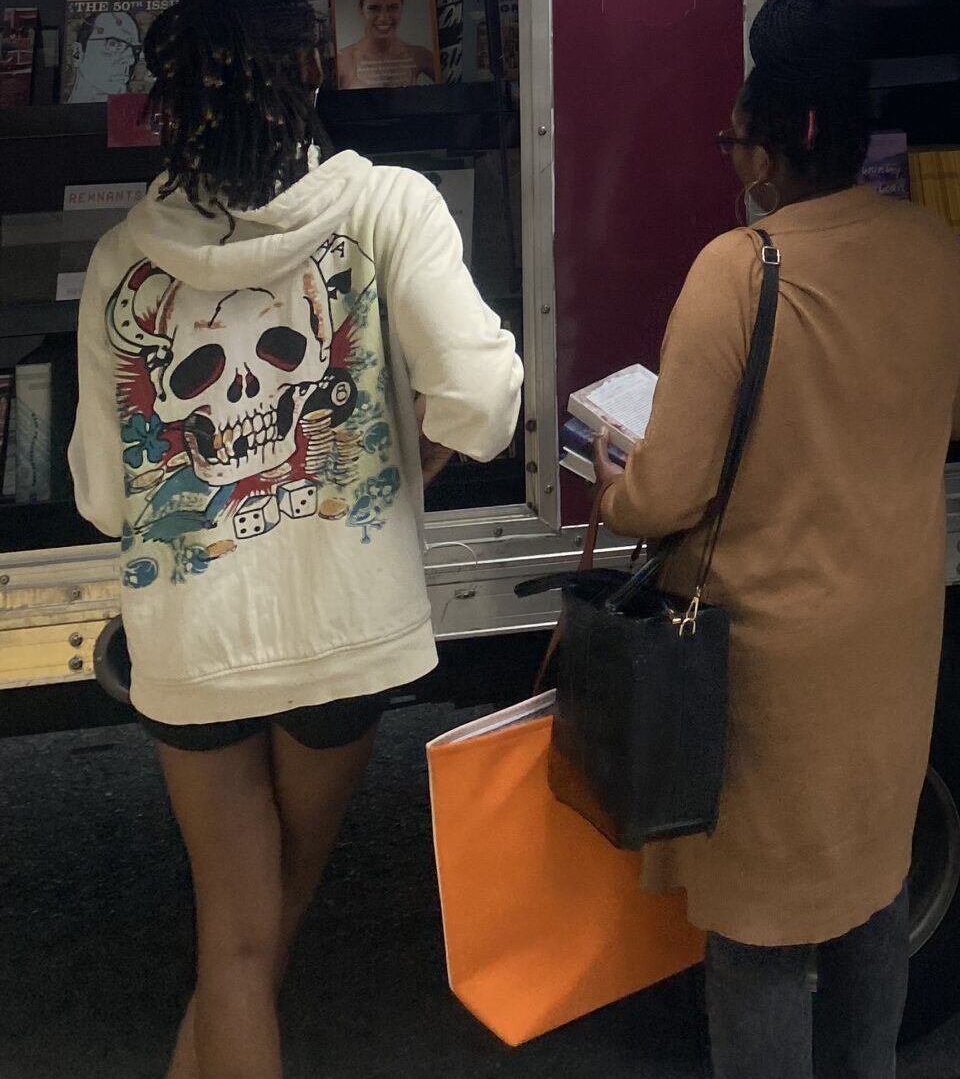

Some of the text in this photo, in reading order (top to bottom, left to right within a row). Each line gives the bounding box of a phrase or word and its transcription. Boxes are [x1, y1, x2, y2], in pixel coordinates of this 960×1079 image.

[75, 1, 109, 12] THE
[69, 190, 143, 204] REMNANTS
[330, 240, 345, 257] A
